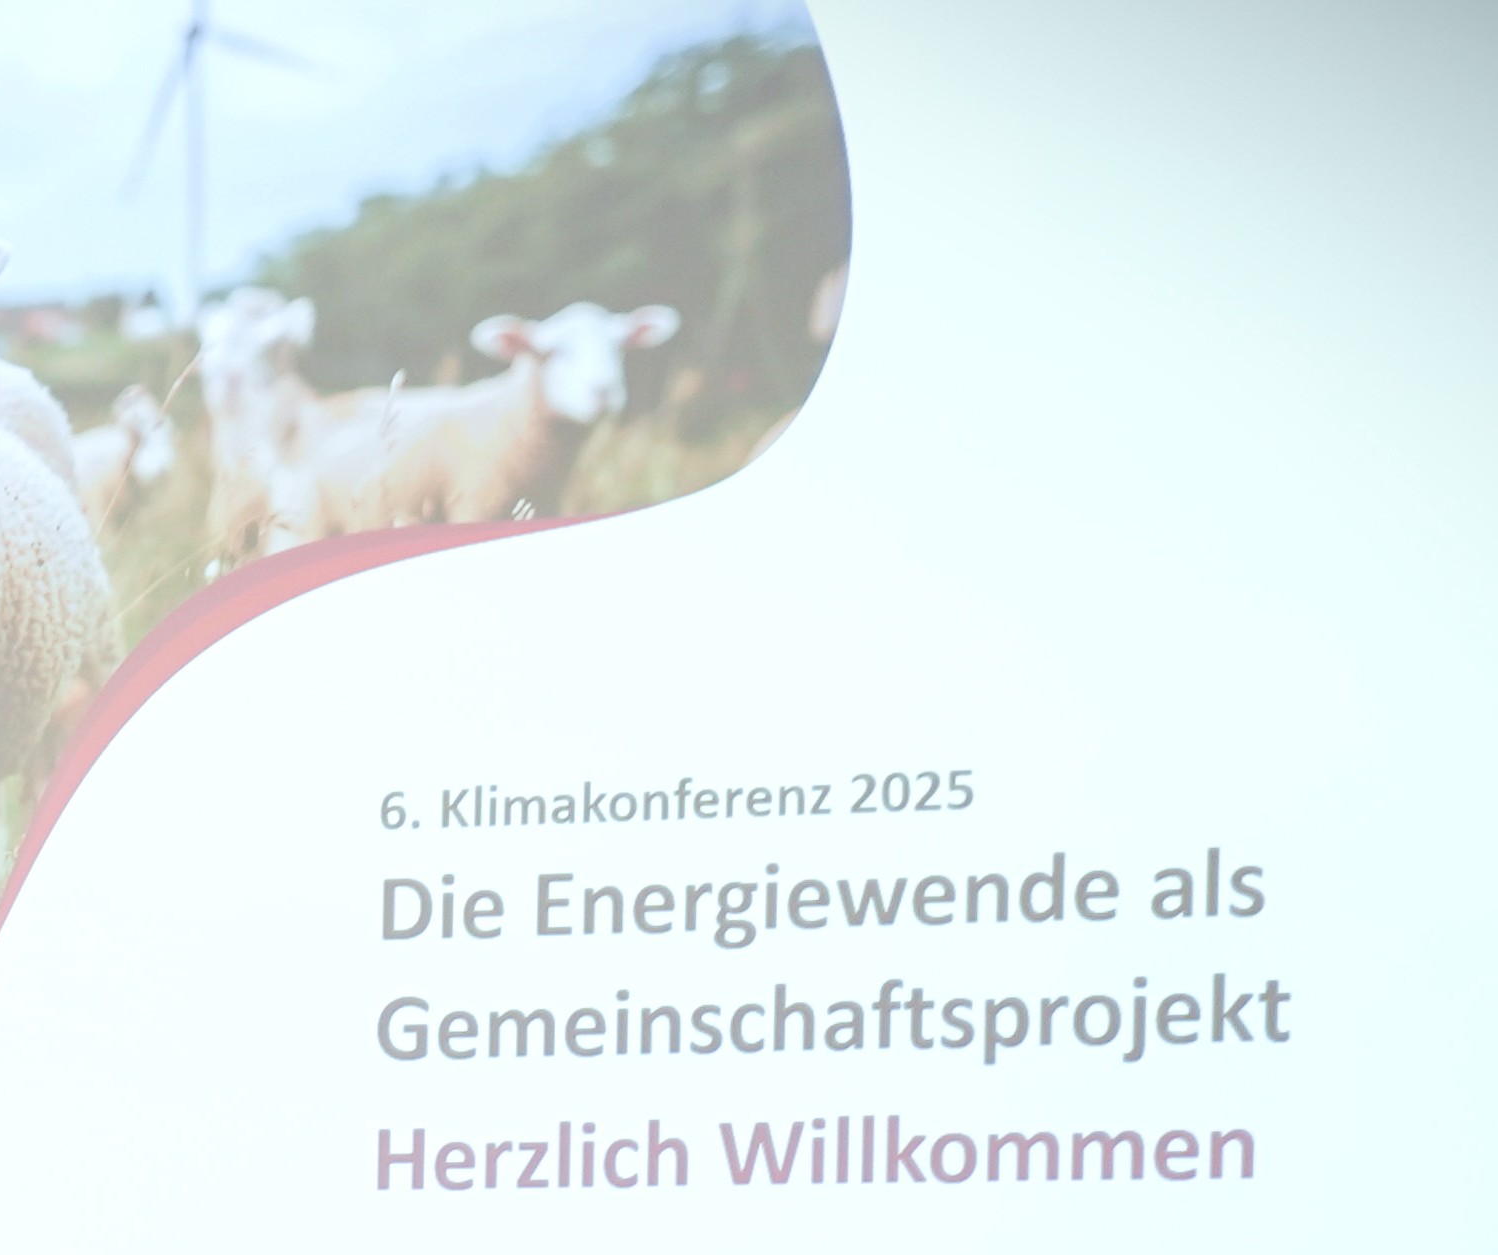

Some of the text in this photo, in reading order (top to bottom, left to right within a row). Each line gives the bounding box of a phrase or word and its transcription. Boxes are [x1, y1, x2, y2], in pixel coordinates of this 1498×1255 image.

[380, 769, 974, 830] 6. Klimakonferenz 2025
[382, 846, 1265, 950] Die Energiewende als
[377, 972, 1292, 1066] Gemeinschaftsprojekt
[377, 1114, 1255, 1191] Herzlich Willkommen
